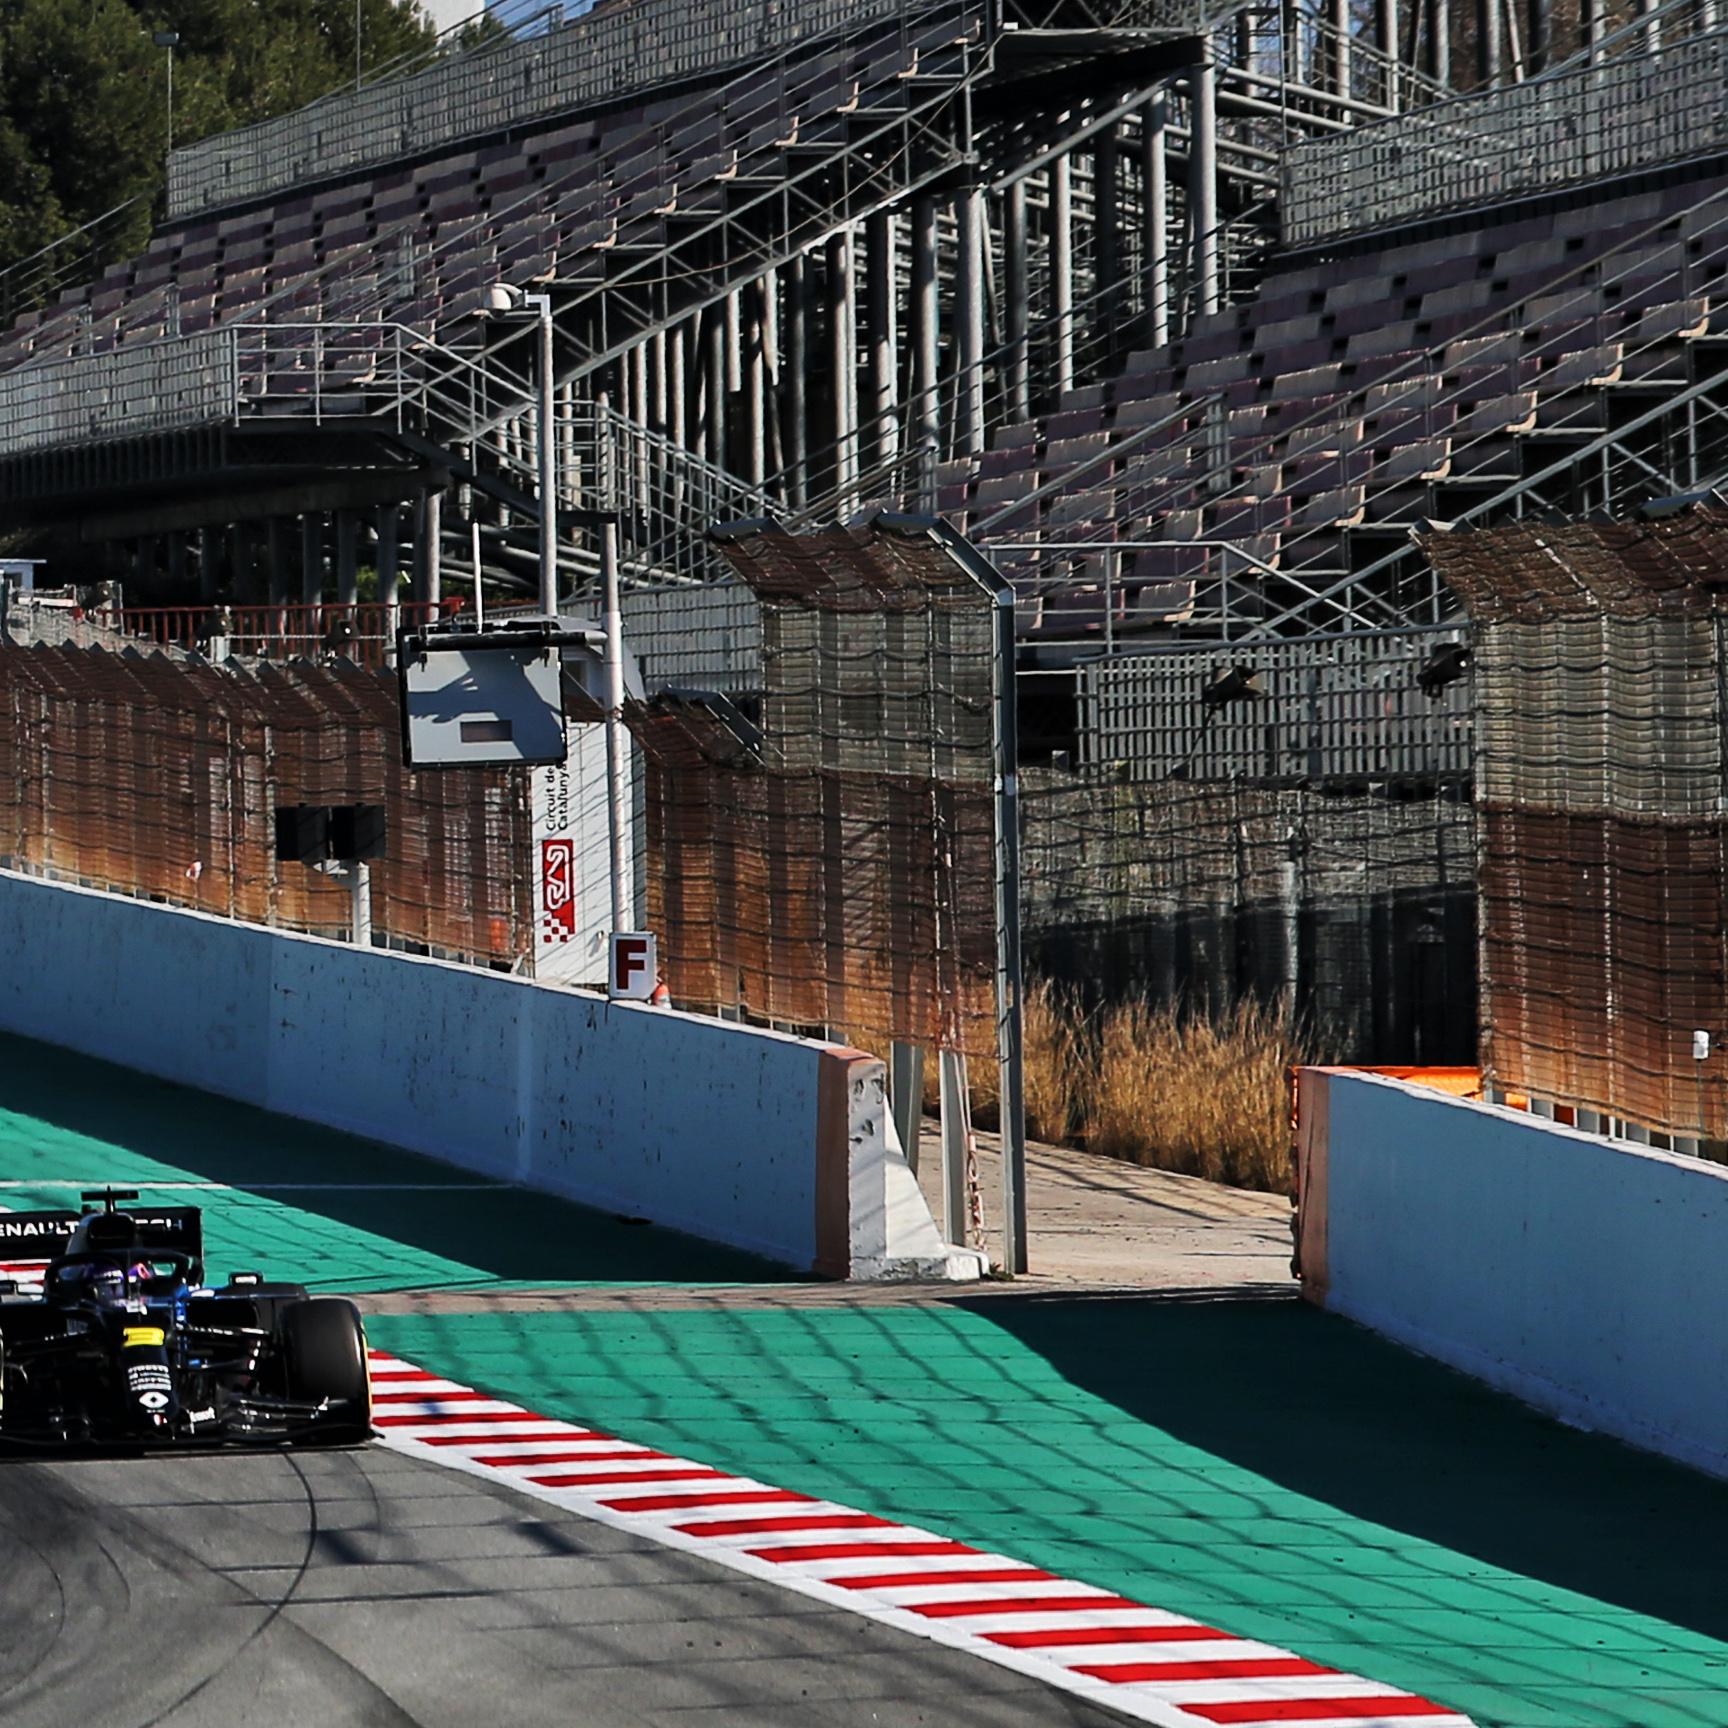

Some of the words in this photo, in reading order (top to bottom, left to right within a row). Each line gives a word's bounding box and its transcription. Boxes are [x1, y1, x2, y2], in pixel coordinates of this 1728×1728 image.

[546, 767, 556, 783] de
[546, 788, 556, 831] Circuit
[616, 939, 647, 990] F
